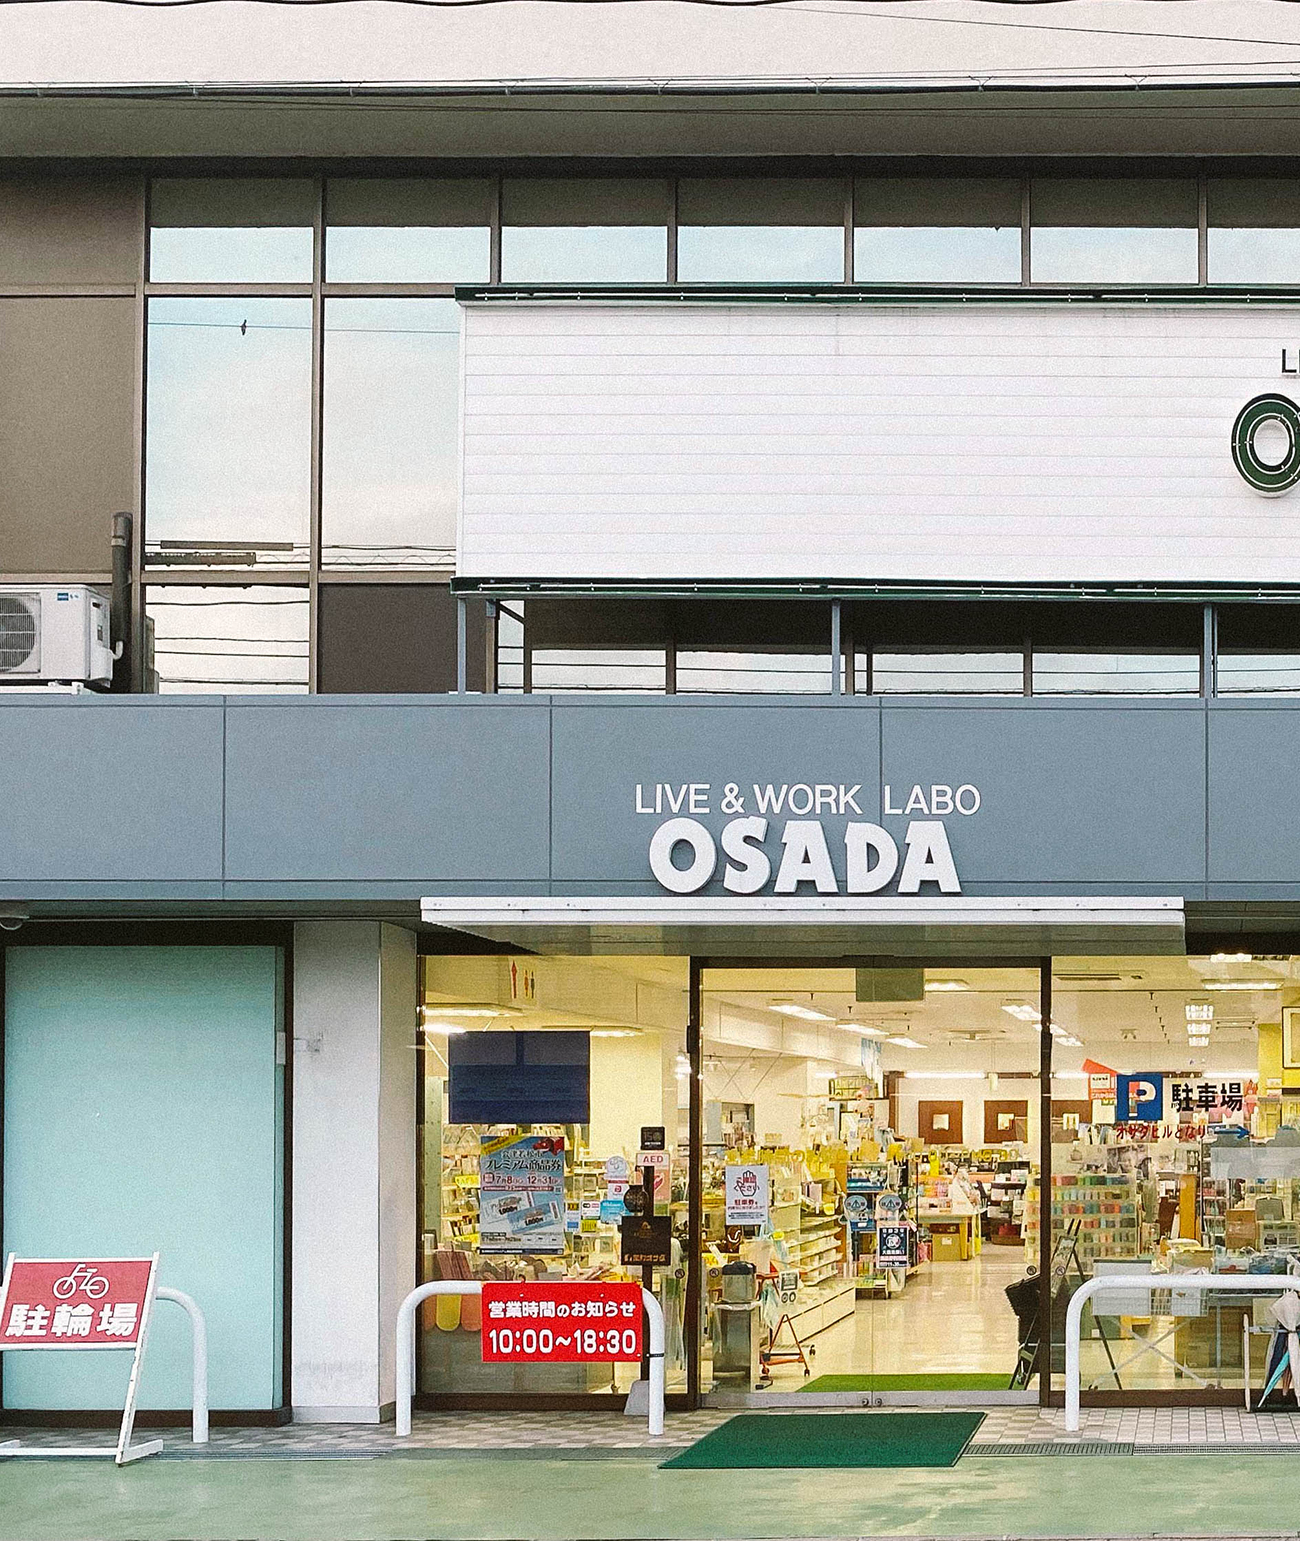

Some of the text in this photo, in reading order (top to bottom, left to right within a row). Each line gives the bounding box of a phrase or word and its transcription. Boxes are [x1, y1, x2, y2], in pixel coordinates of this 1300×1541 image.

[635, 782, 981, 816] LIVE & WORK LABO
[649, 815, 963, 894] OSADA
[1128, 1080, 1157, 1117] P
[1171, 1082, 1244, 1113] 駐車場
[643, 1155, 664, 1163] AED
[5, 1303, 138, 1337] 駐輪場
[488, 1301, 636, 1318] 営業時間のお知らせ
